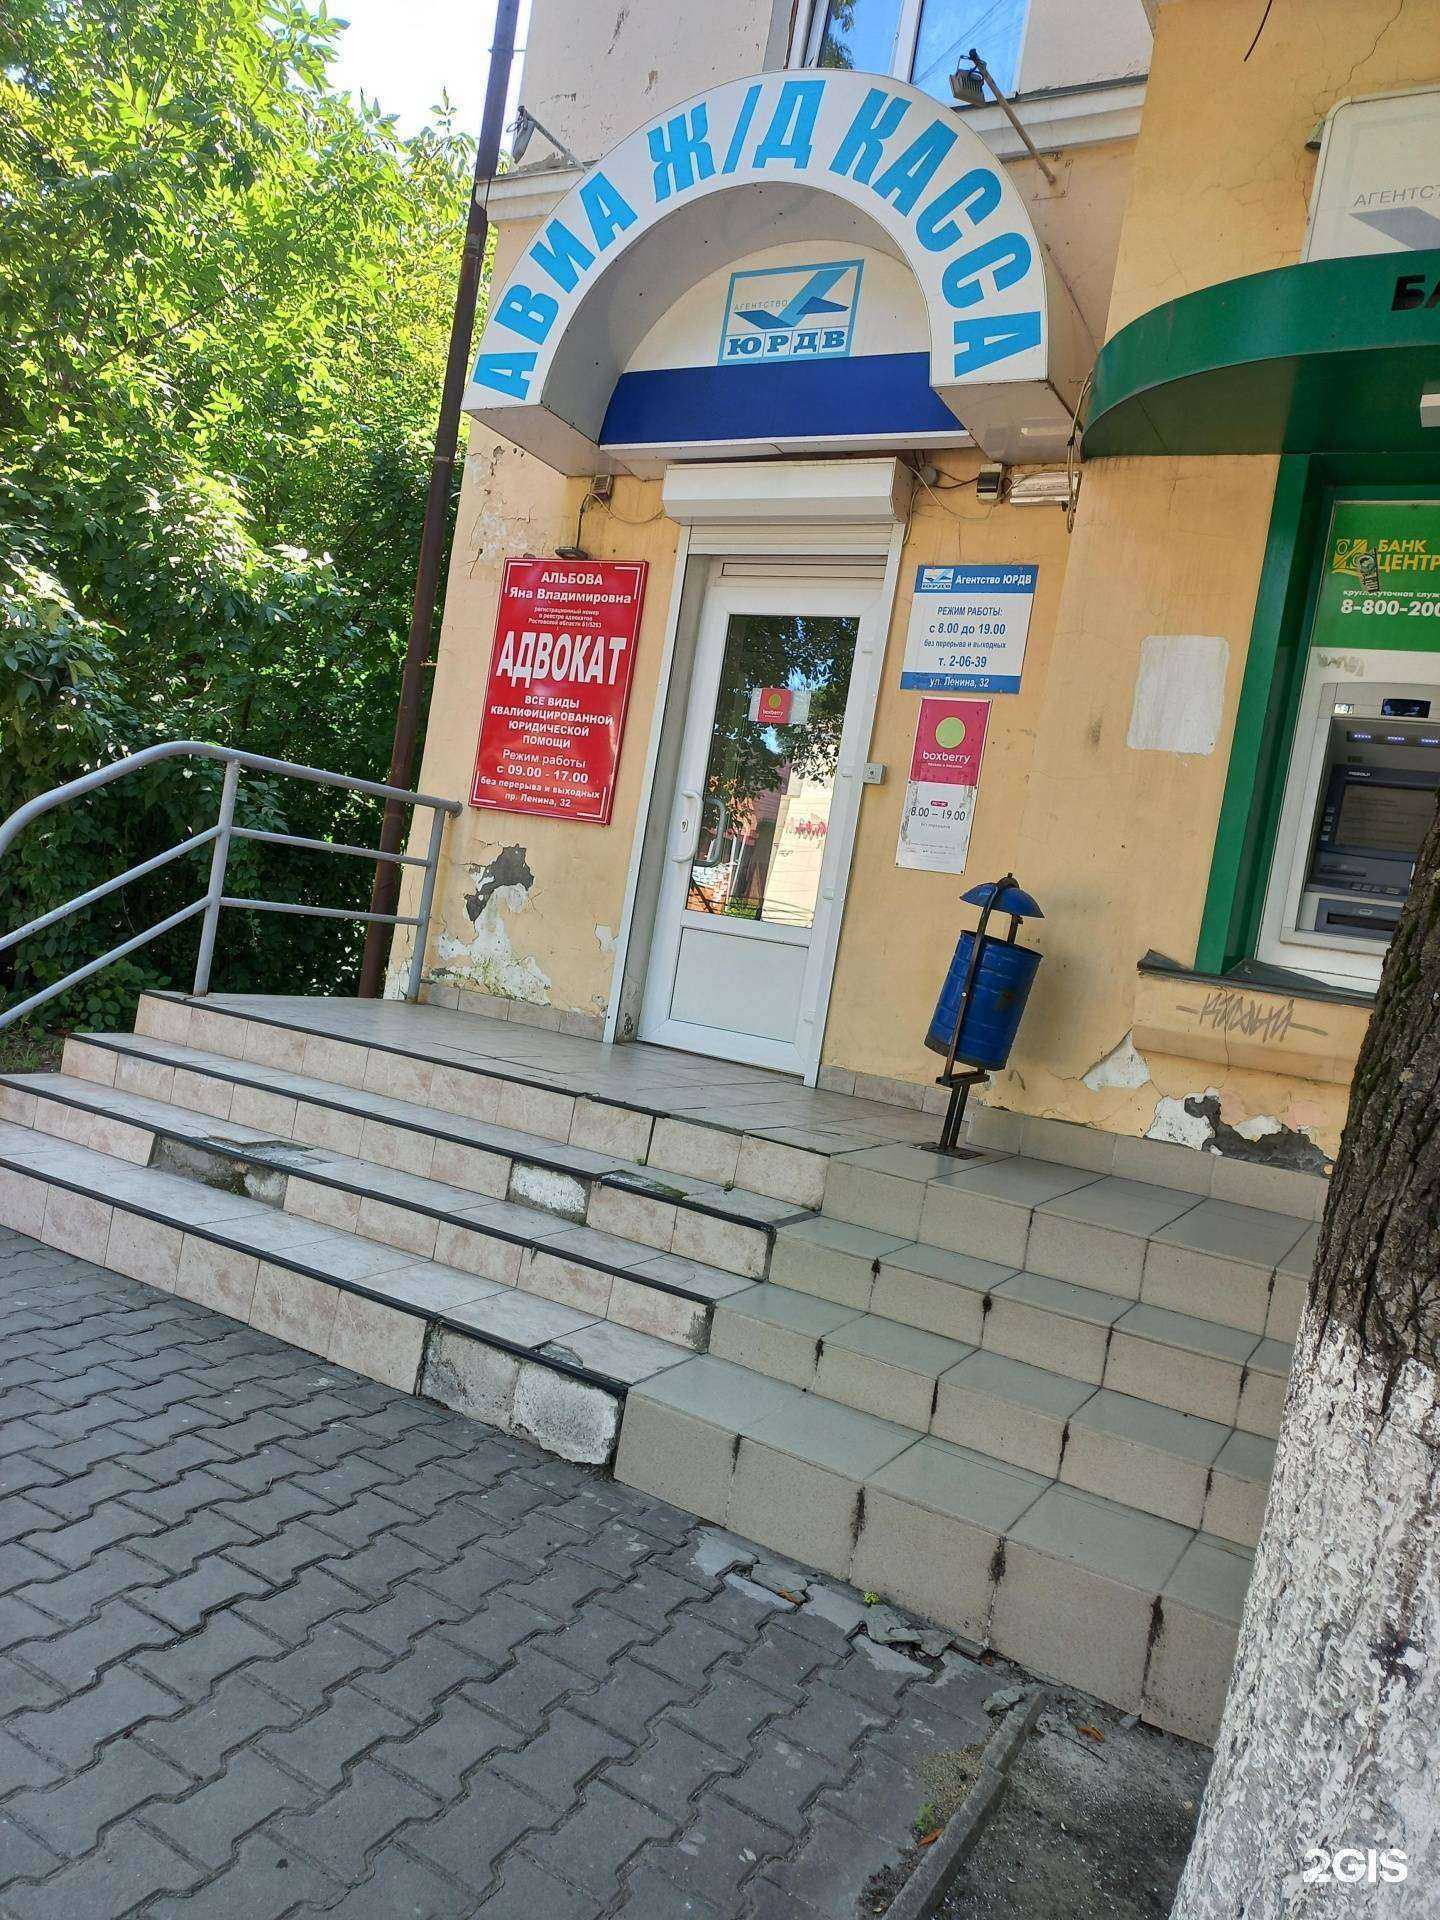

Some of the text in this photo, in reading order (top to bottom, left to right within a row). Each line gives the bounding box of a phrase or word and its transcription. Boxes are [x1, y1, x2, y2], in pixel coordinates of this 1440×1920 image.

[1353, 184, 1440, 207] АГЕНТС
[472, 80, 1042, 400] АВИА Ж/Д КАССА
[734, 299, 789, 311] АГЕНТСТВО
[727, 330, 845, 356] ЮРДВ
[1378, 539, 1427, 553] БАНК
[1377, 553, 1440, 573] ЦЕНТР
[540, 571, 604, 585] АЛЬБОВА
[955, 575, 1001, 585] Агентство
[1002, 574, 1032, 586] ЮРДВ
[509, 586, 632, 605] Яна Владимировна
[937, 606, 1003, 617] РЕЖИМ РАБОТЫ:
[929, 623, 1006, 635] с 8.00 до 19.00
[935, 640, 966, 649] перерыва
[973, 642, 1007, 650] выходных
[496, 630, 627, 688] АДВОКАТ
[938, 655, 987, 668] т. 2-06-39
[929, 676, 990, 688] ул. Ленина, 32
[524, 695, 580, 709] ВСЕ ВИДЫ
[490, 705, 614, 726] КВАЛИФИЦИРОВАННОЙ
[508, 720, 590, 737] ЮРИДИЧЕСКОЙ
[522, 734, 572, 749] ПОМОЩИ
[502, 748, 586, 768] Режим работы
[922, 750, 972, 764] boxberry
[496, 766, 504, 774] с
[507, 764, 542, 778] 09.00
[554, 770, 589, 784] 17.00
[480, 776, 497, 786] без
[498, 780, 542, 792] перерыва
[553, 786, 600, 799] выходных
[505, 792, 571, 808] пр. Ленина, 32
[910, 806, 930, 818] 8.00
[941, 809, 966, 821] 19.00
